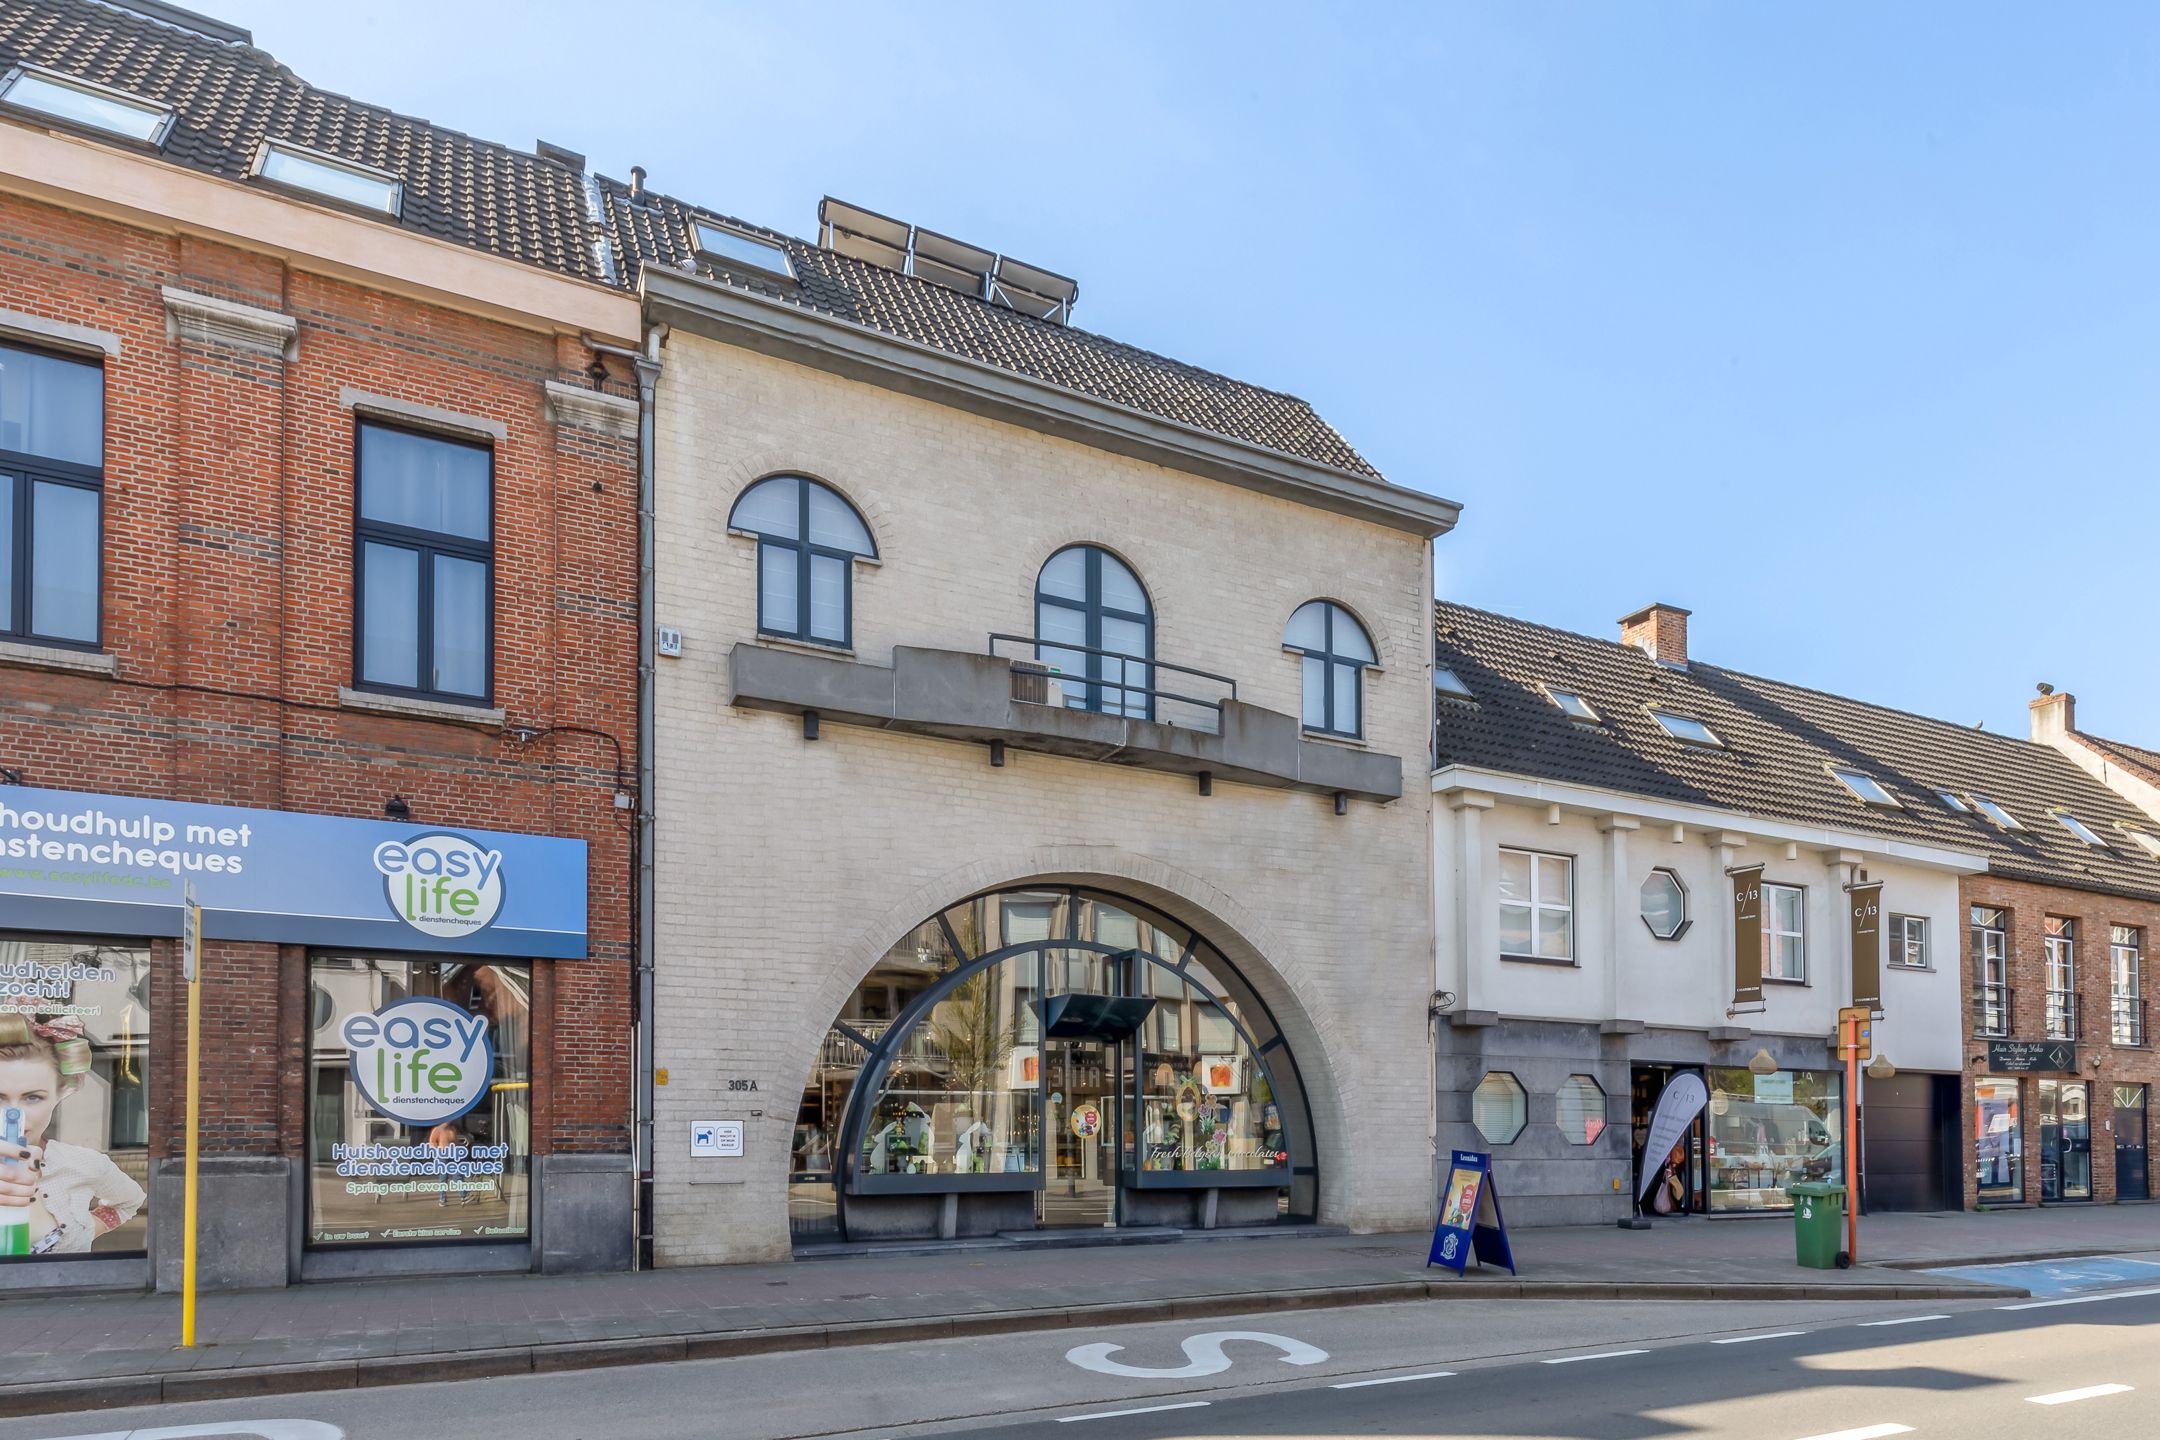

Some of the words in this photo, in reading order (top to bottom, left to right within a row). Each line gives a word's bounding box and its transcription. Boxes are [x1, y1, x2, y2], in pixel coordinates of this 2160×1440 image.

[186, 823, 252, 848] met
[377, 844, 498, 890] easy
[406, 873, 480, 921] life
[418, 915, 482, 927] dienstencheques
[20, 1005, 36, 1014] en
[343, 1015, 484, 1063] easy
[377, 1048, 463, 1103] life
[392, 1096, 465, 1106] dienstencheques
[332, 1143, 467, 1162] Huishoudhulp
[471, 1143, 508, 1160] met
[336, 1159, 504, 1177] dienstencheques
[346, 1181, 388, 1196] Spring
[390, 1181, 416, 1193] snel
[418, 1182, 448, 1193] even
